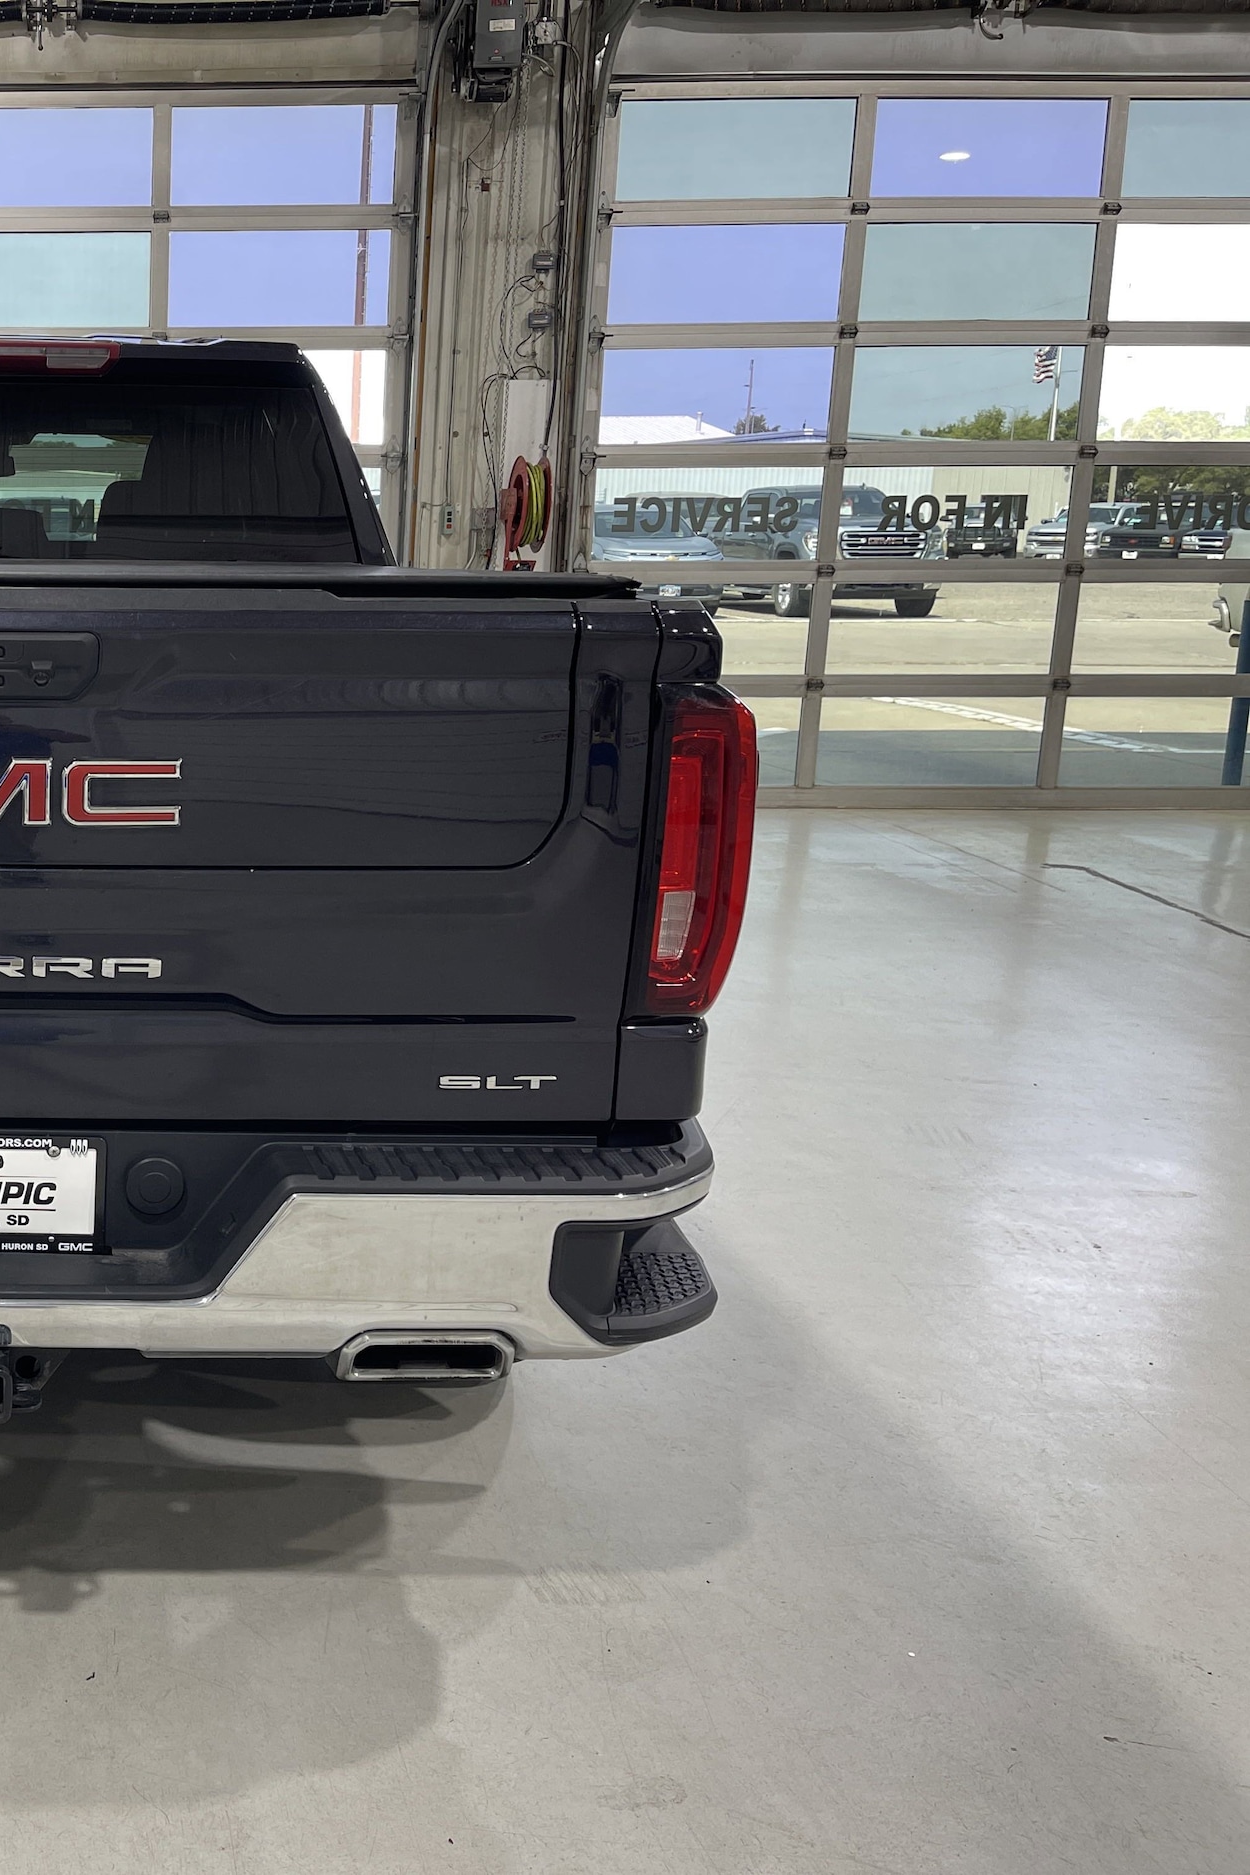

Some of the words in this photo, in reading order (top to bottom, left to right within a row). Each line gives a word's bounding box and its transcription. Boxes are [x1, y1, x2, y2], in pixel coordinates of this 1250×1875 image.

[438, 1076, 558, 1090] SLT
[6, 1214, 30, 1226] SD
[1, 1242, 32, 1251] HURON
[33, 1243, 49, 1251] SD
[58, 1242, 93, 1252] GMC
